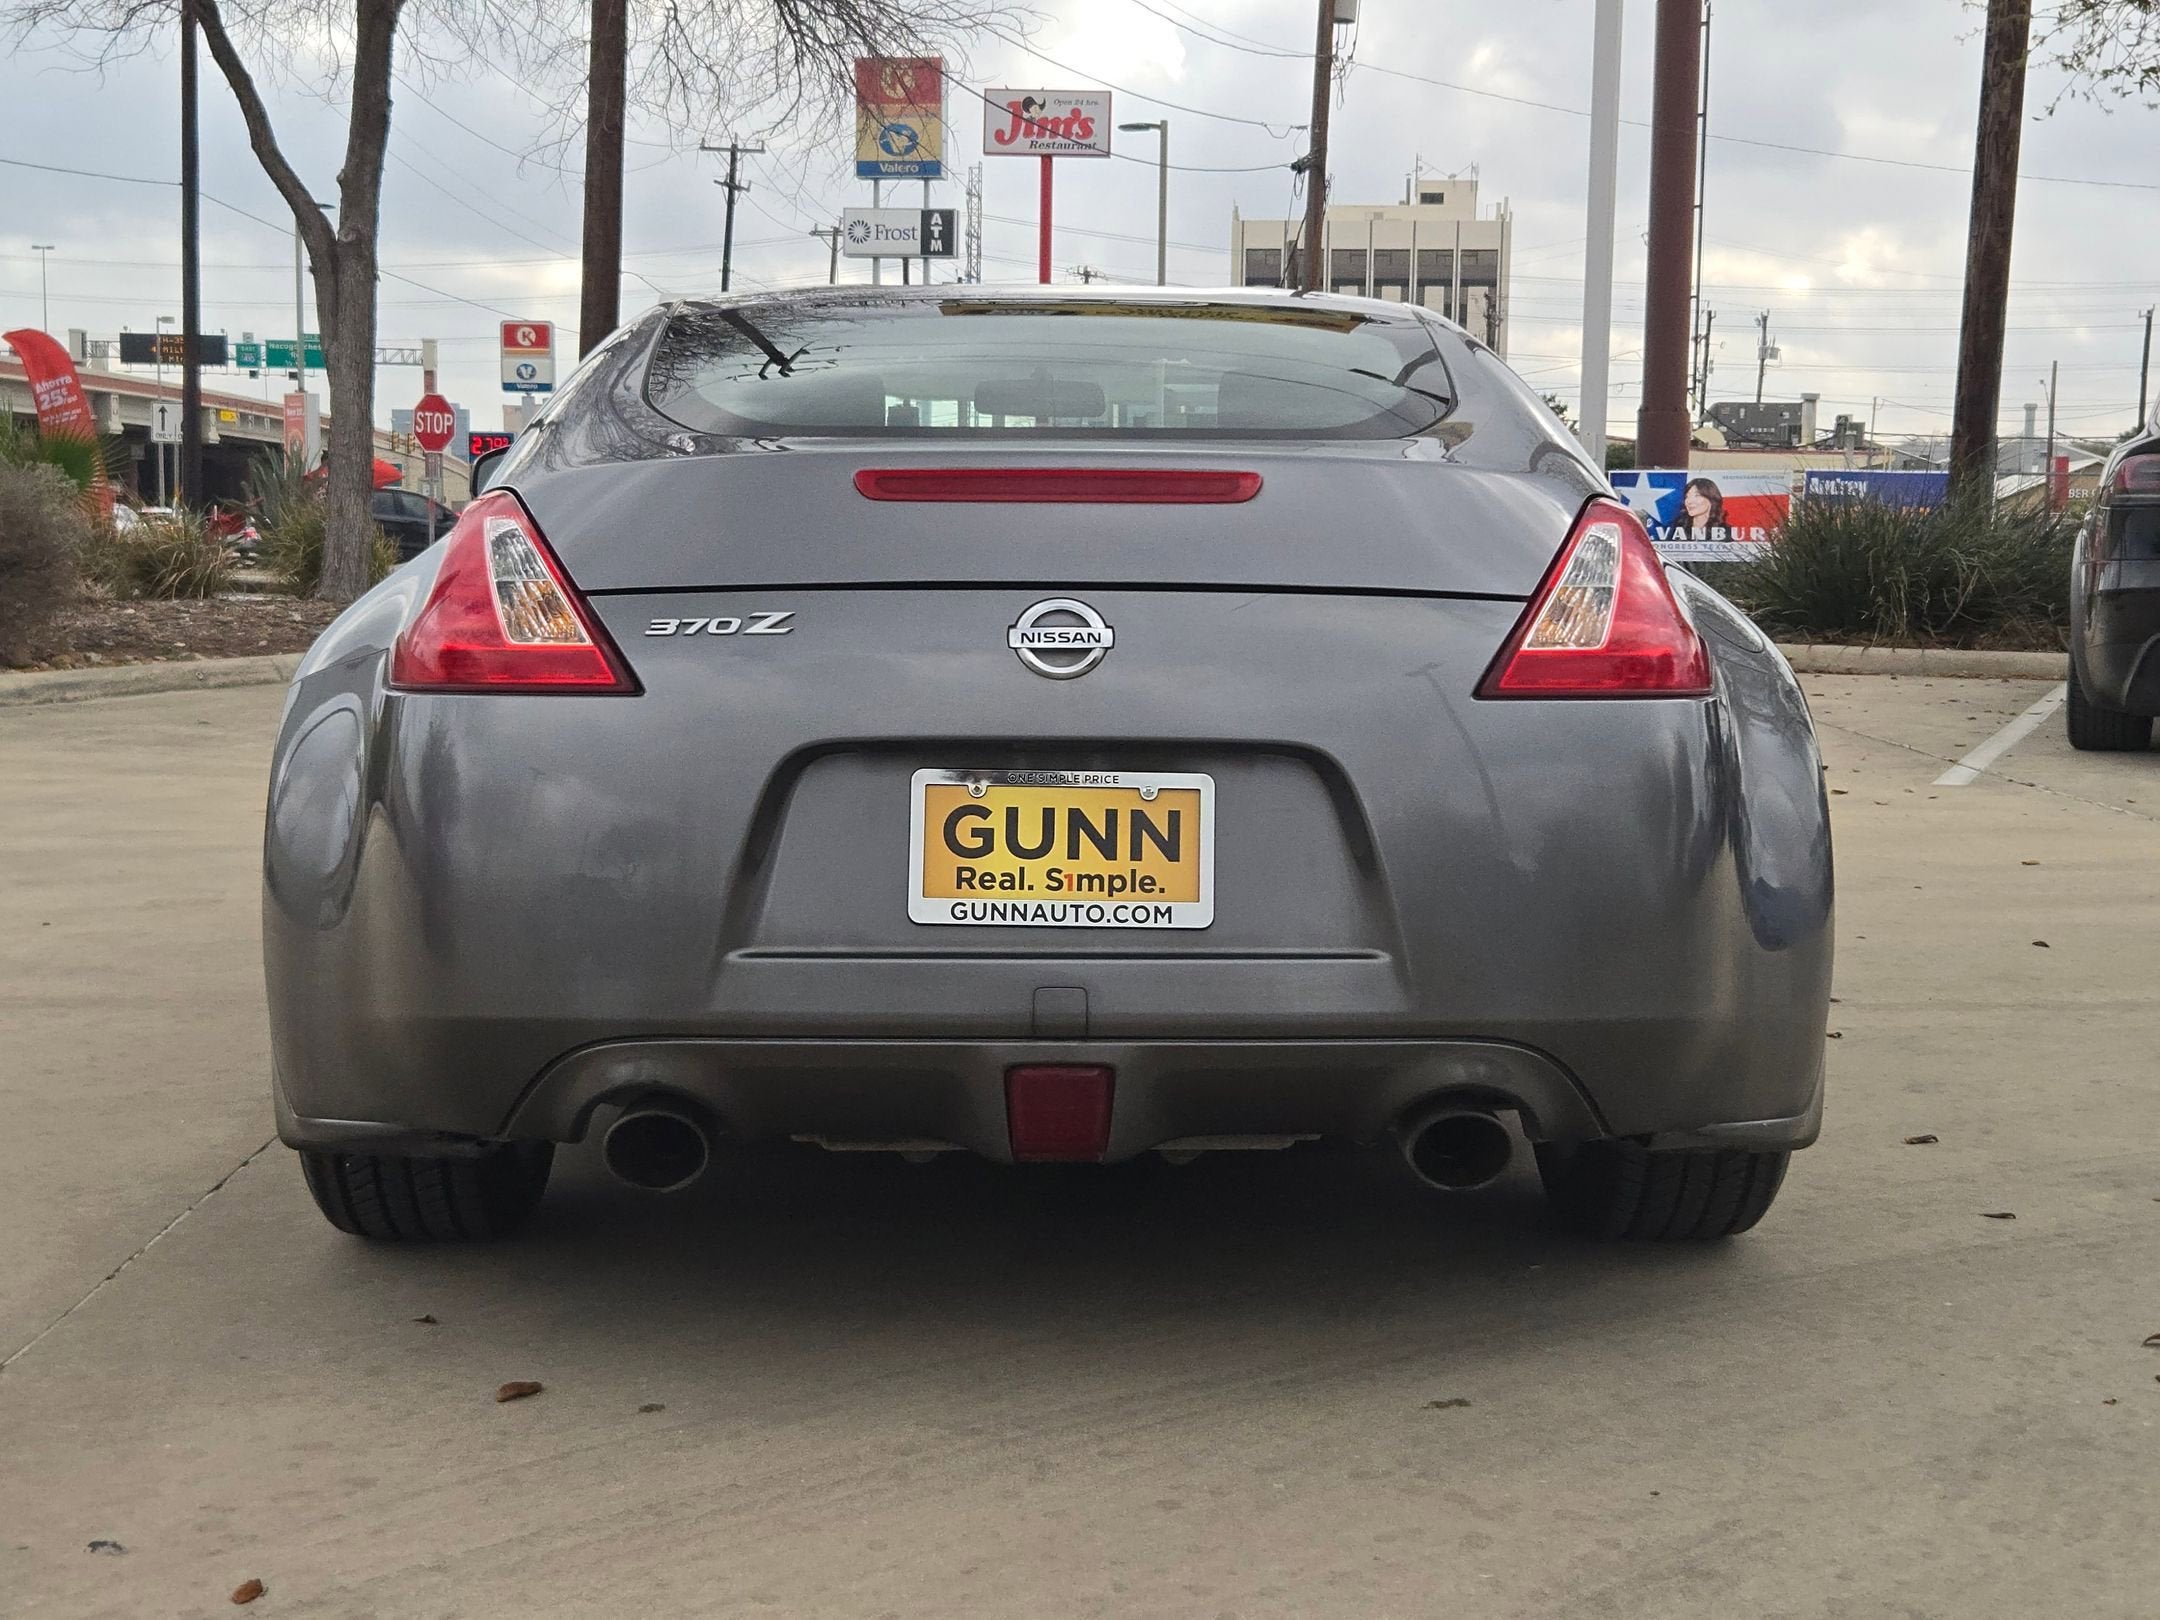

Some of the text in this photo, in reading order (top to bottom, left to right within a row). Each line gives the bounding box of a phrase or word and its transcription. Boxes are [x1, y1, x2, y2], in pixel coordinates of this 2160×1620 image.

[1053, 99, 1072, 107] Open
[994, 100, 1095, 145] Jim's
[1029, 140, 1096, 150] Restaurant
[880, 163, 919, 173] Valero
[874, 224, 918, 240] Frost
[930, 212, 943, 252] ATM
[35, 375, 73, 394] Ahorra
[415, 412, 453, 434] STOP
[645, 611, 796, 636] 370Z
[1020, 632, 1102, 643] NISSAN
[1007, 773, 1120, 784] ONE SIMPLE PRICE
[942, 804, 1181, 862] GUNN
[956, 866, 1034, 891] Real.
[950, 902, 1172, 924] GUNNAUTO.COM
